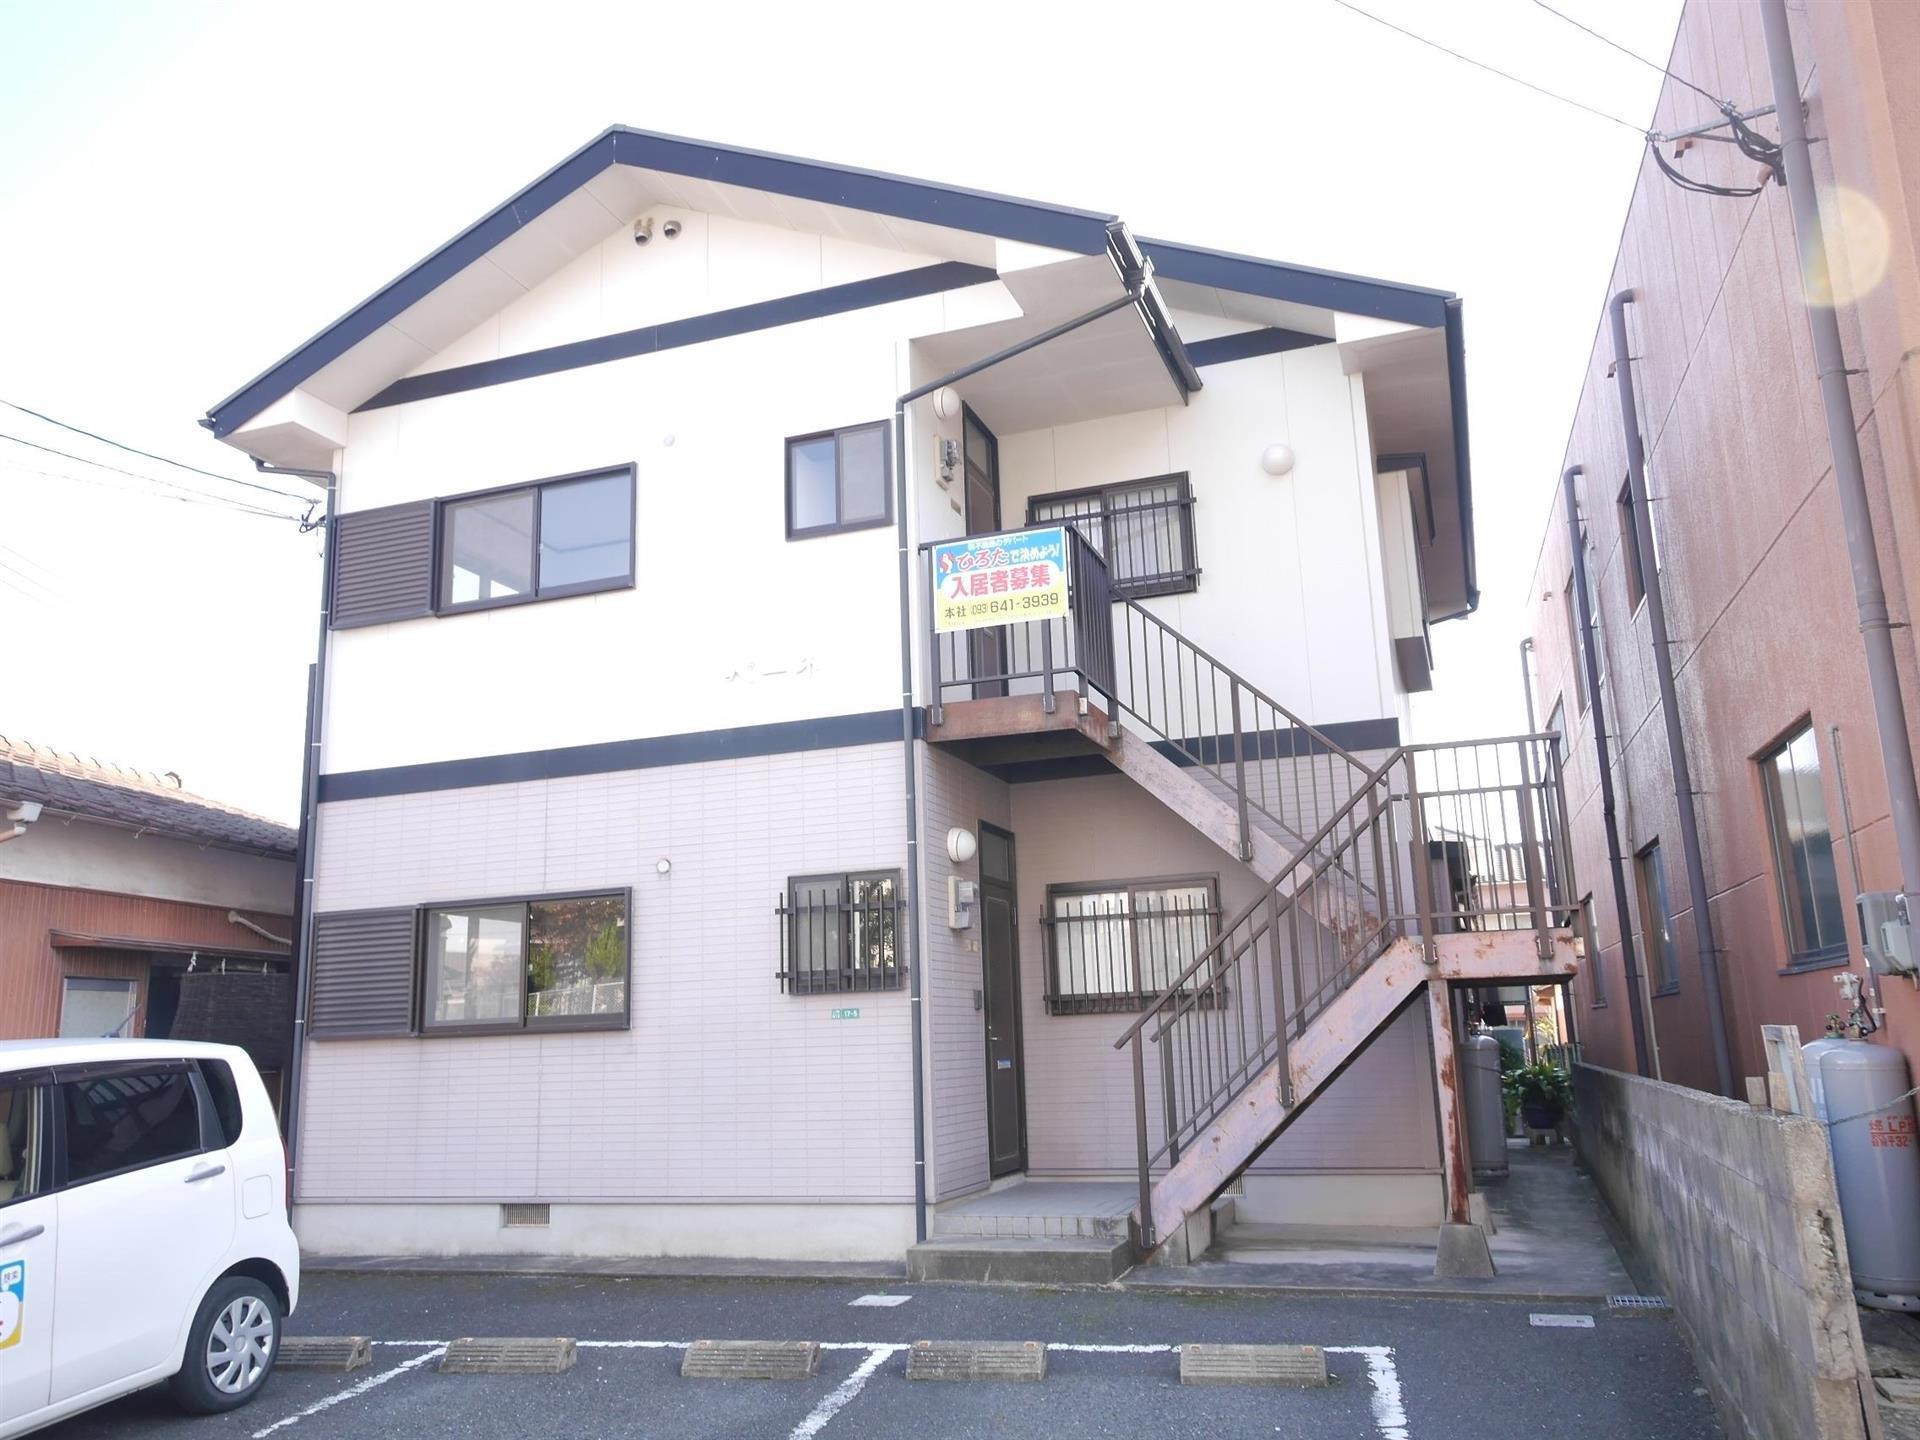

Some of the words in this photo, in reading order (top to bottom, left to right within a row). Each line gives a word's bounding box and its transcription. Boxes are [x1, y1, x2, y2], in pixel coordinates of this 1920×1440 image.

[950, 564, 1050, 599] 入居者募集
[944, 605, 967, 619] 本社
[990, 592, 1059, 614] 641-3939
